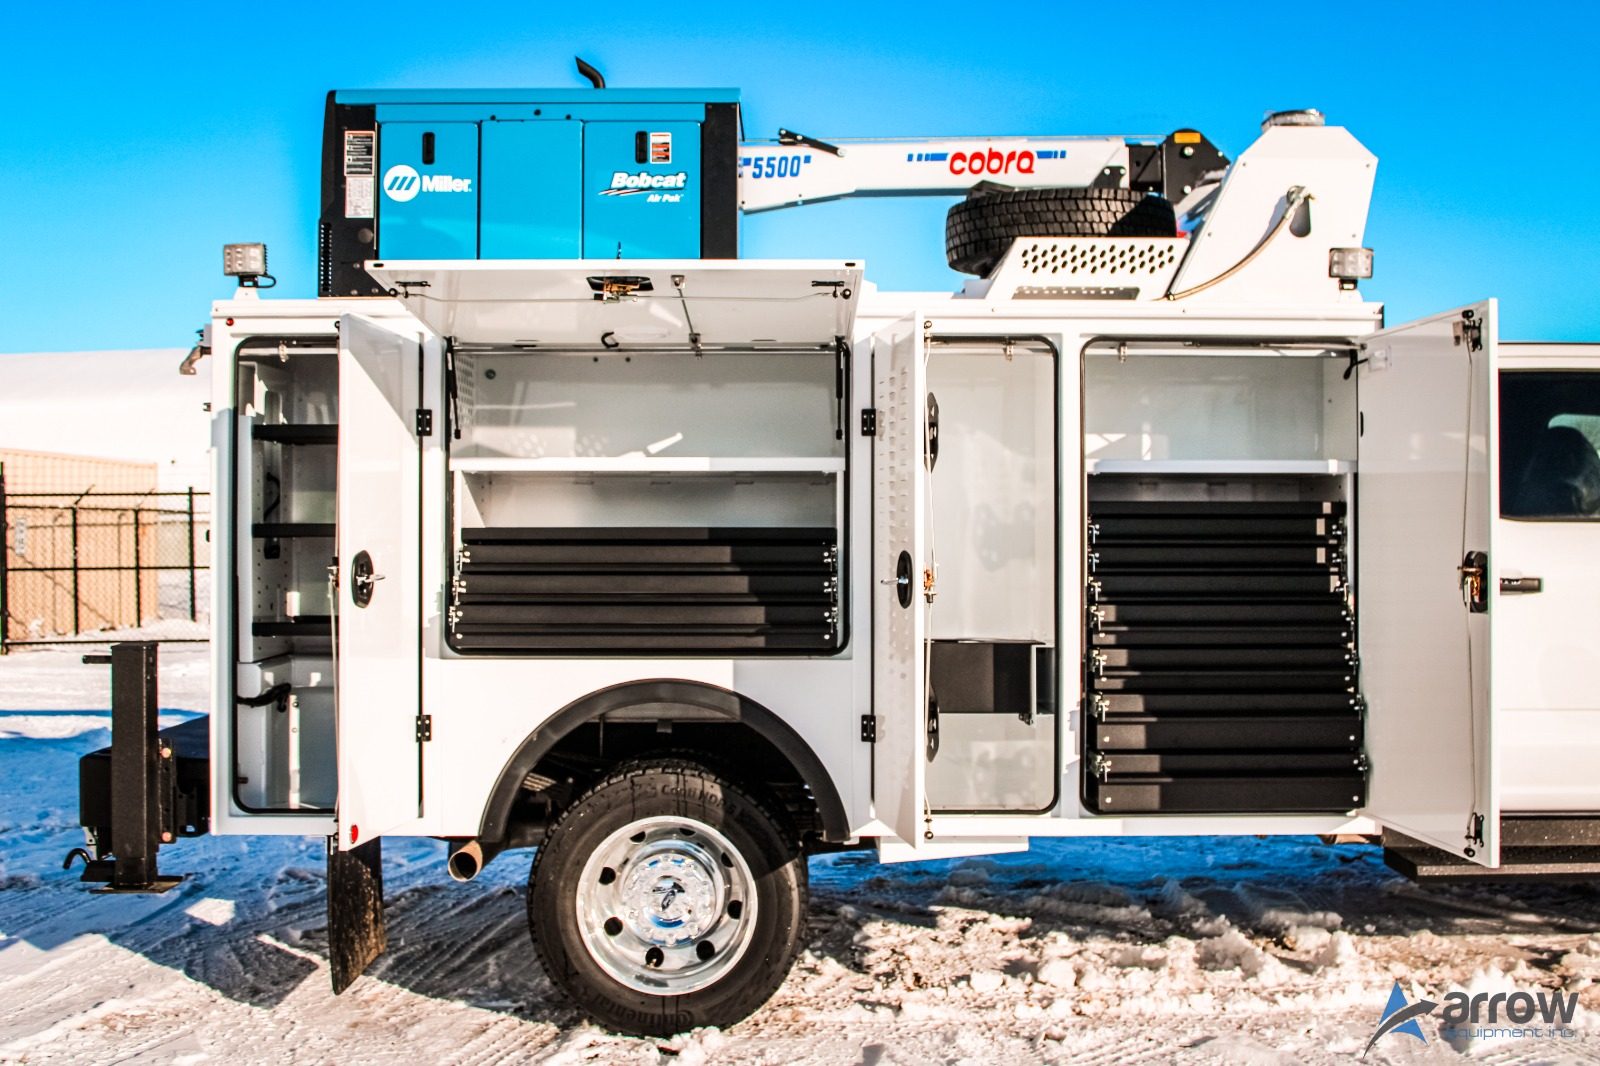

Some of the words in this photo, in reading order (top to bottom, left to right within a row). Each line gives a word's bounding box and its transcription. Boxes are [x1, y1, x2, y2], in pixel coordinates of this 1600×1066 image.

[752, 156, 801, 178] 5500
[949, 147, 1035, 175] cobra
[610, 172, 687, 189] Bobcat
[647, 194, 662, 203] Air
